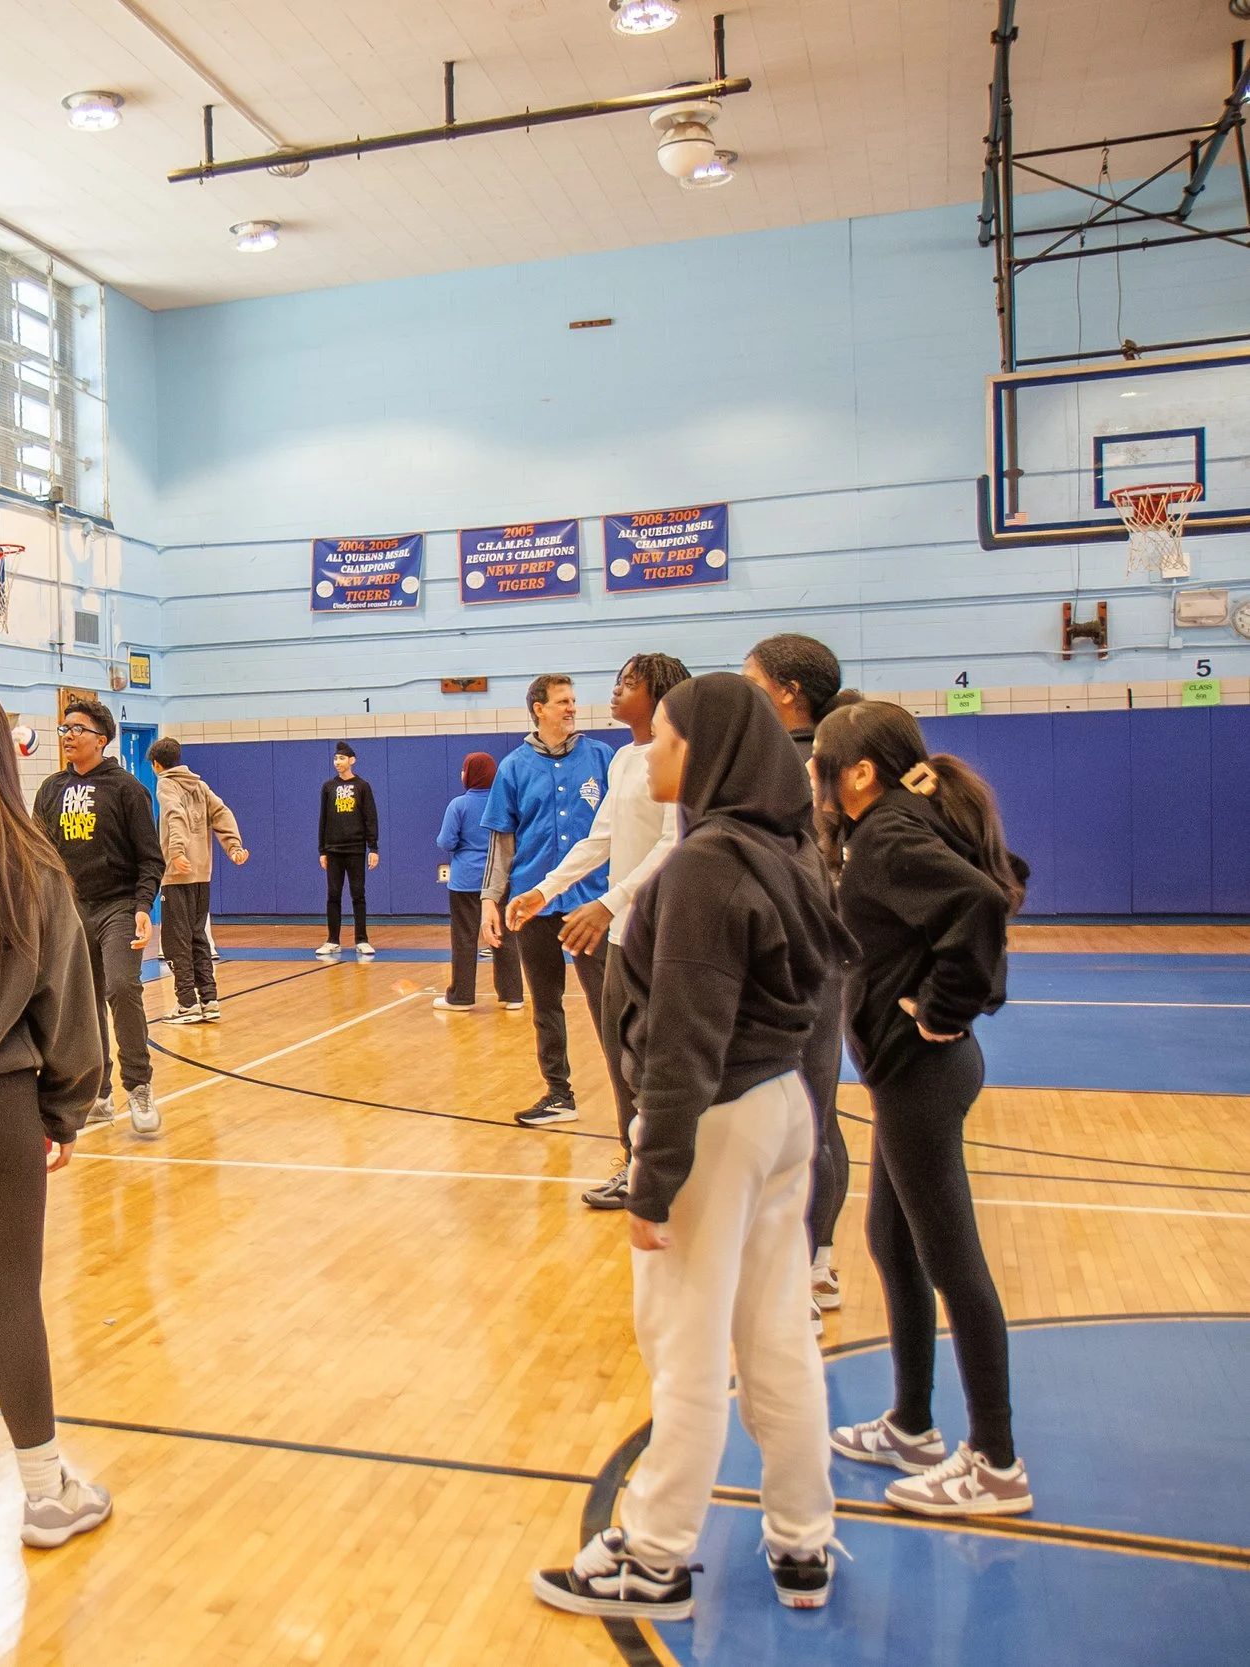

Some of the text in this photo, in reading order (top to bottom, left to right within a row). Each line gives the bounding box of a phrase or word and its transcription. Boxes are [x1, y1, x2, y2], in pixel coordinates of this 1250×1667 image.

[631, 509, 701, 527] 2008-2009
[503, 525, 535, 539] 2005
[618, 521, 714, 539] ALL QUEENS MSBL
[337, 539, 399, 552] 2004-2005
[477, 535, 562, 551] C.H.A.M.P.S. MSBL
[635, 535, 699, 549] CHAMPIONS
[326, 548, 410, 563] ALL QUEENS MSBL
[466, 546, 575, 564] REGION 3 CHAMPIONS
[631, 547, 705, 565] NEW PREP
[340, 561, 396, 573] CHAMPIONS
[486, 561, 556, 577] NEW PREP
[643, 564, 694, 580] TIGERS
[334, 573, 401, 587] NEW PREP
[498, 577, 545, 592] TIGERS
[345, 589, 391, 602] TIGERS
[1196, 659, 1212, 677] 5
[955, 671, 970, 688] 4
[121, 705, 127, 720] A
[362, 697, 370, 713] 1
